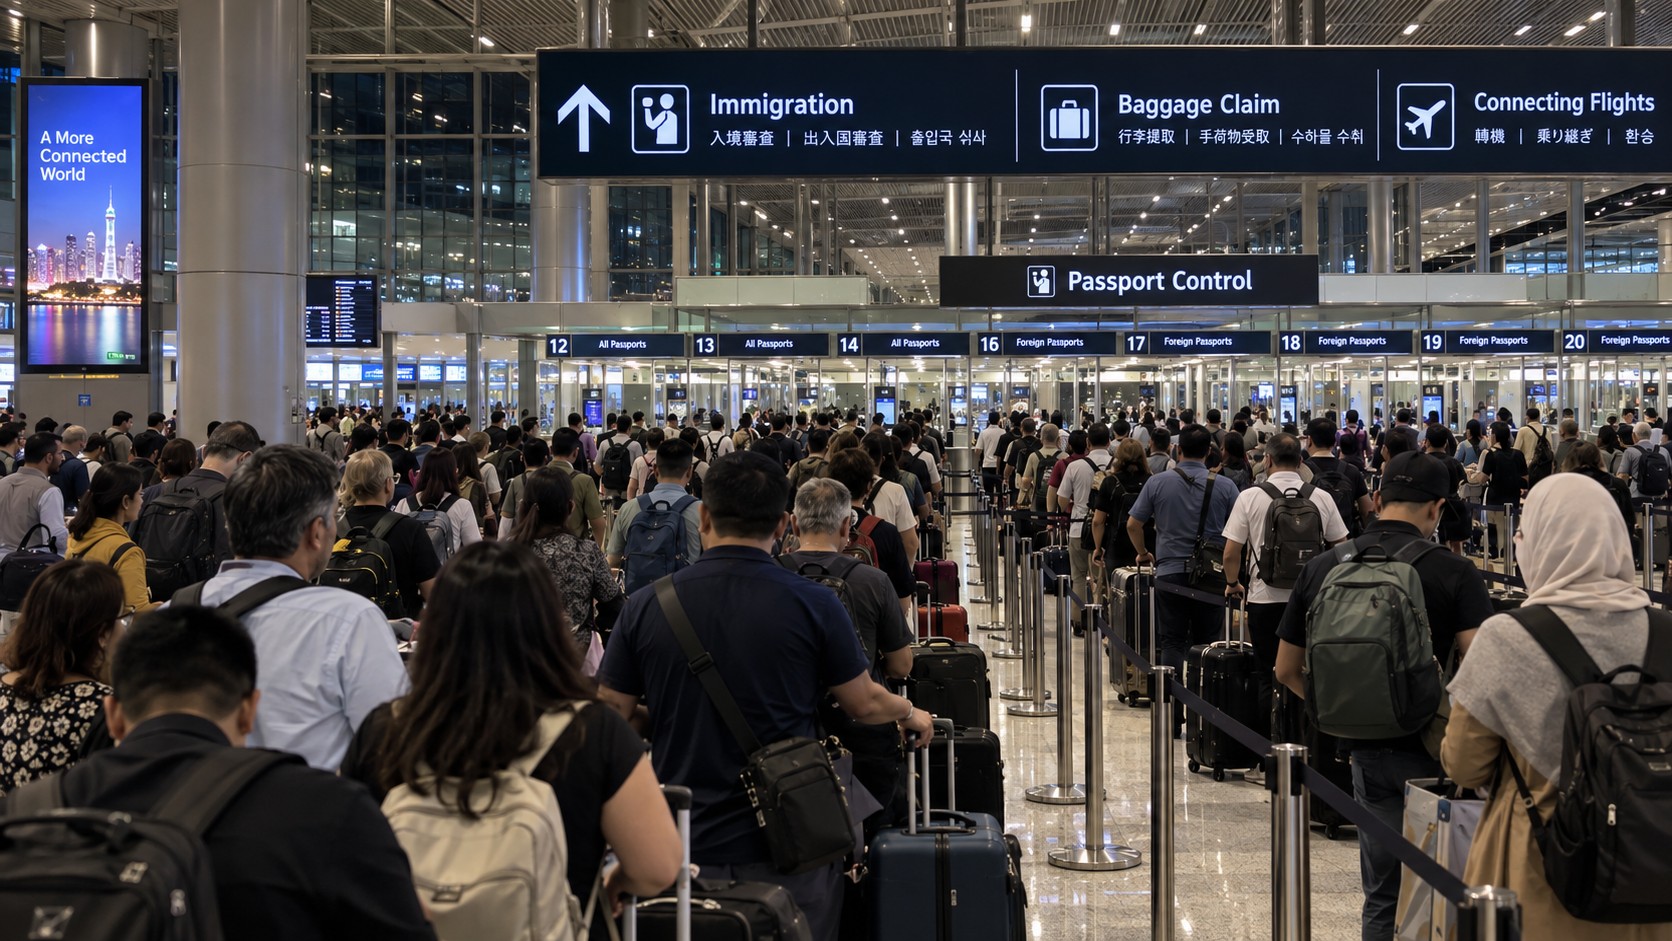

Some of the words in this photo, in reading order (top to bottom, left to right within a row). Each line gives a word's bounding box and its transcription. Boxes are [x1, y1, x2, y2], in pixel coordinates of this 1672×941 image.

[710, 92, 854, 120] Immigration
[1118, 93, 1213, 120] Baggage
[1220, 92, 1280, 114] Claim
[1474, 91, 1584, 116] Connecting
[1590, 91, 1655, 116] Flights
[40, 131, 51, 145] A
[55, 130, 95, 145] More
[910, 129, 954, 146] 출입국
[1118, 128, 1175, 145] 行李提取
[1199, 128, 1270, 145] 手荷物受取
[1474, 127, 1506, 144] 轉機
[1625, 128, 1655, 145] 환승
[40, 148, 127, 164] Connected
[40, 166, 86, 182] World
[1068, 270, 1166, 296] Passport
[1172, 269, 1253, 291] Control
[549, 338, 569, 354] 12
[598, 339, 609, 349] All
[696, 337, 715, 354] 13
[744, 339, 756, 348] All
[839, 337, 859, 353] 14
[890, 338, 902, 347] All
[980, 336, 1000, 352] 16
[1016, 337, 1045, 348] Foreign
[1127, 336, 1146, 352] 17
[1164, 336, 1194, 348] Foreign
[1281, 335, 1301, 351] 18
[1318, 336, 1348, 347] Foreign
[1423, 334, 1443, 350] 19
[1459, 336, 1489, 346] Foreign
[1564, 333, 1586, 350] 20
[1600, 335, 1631, 346] Foreign
